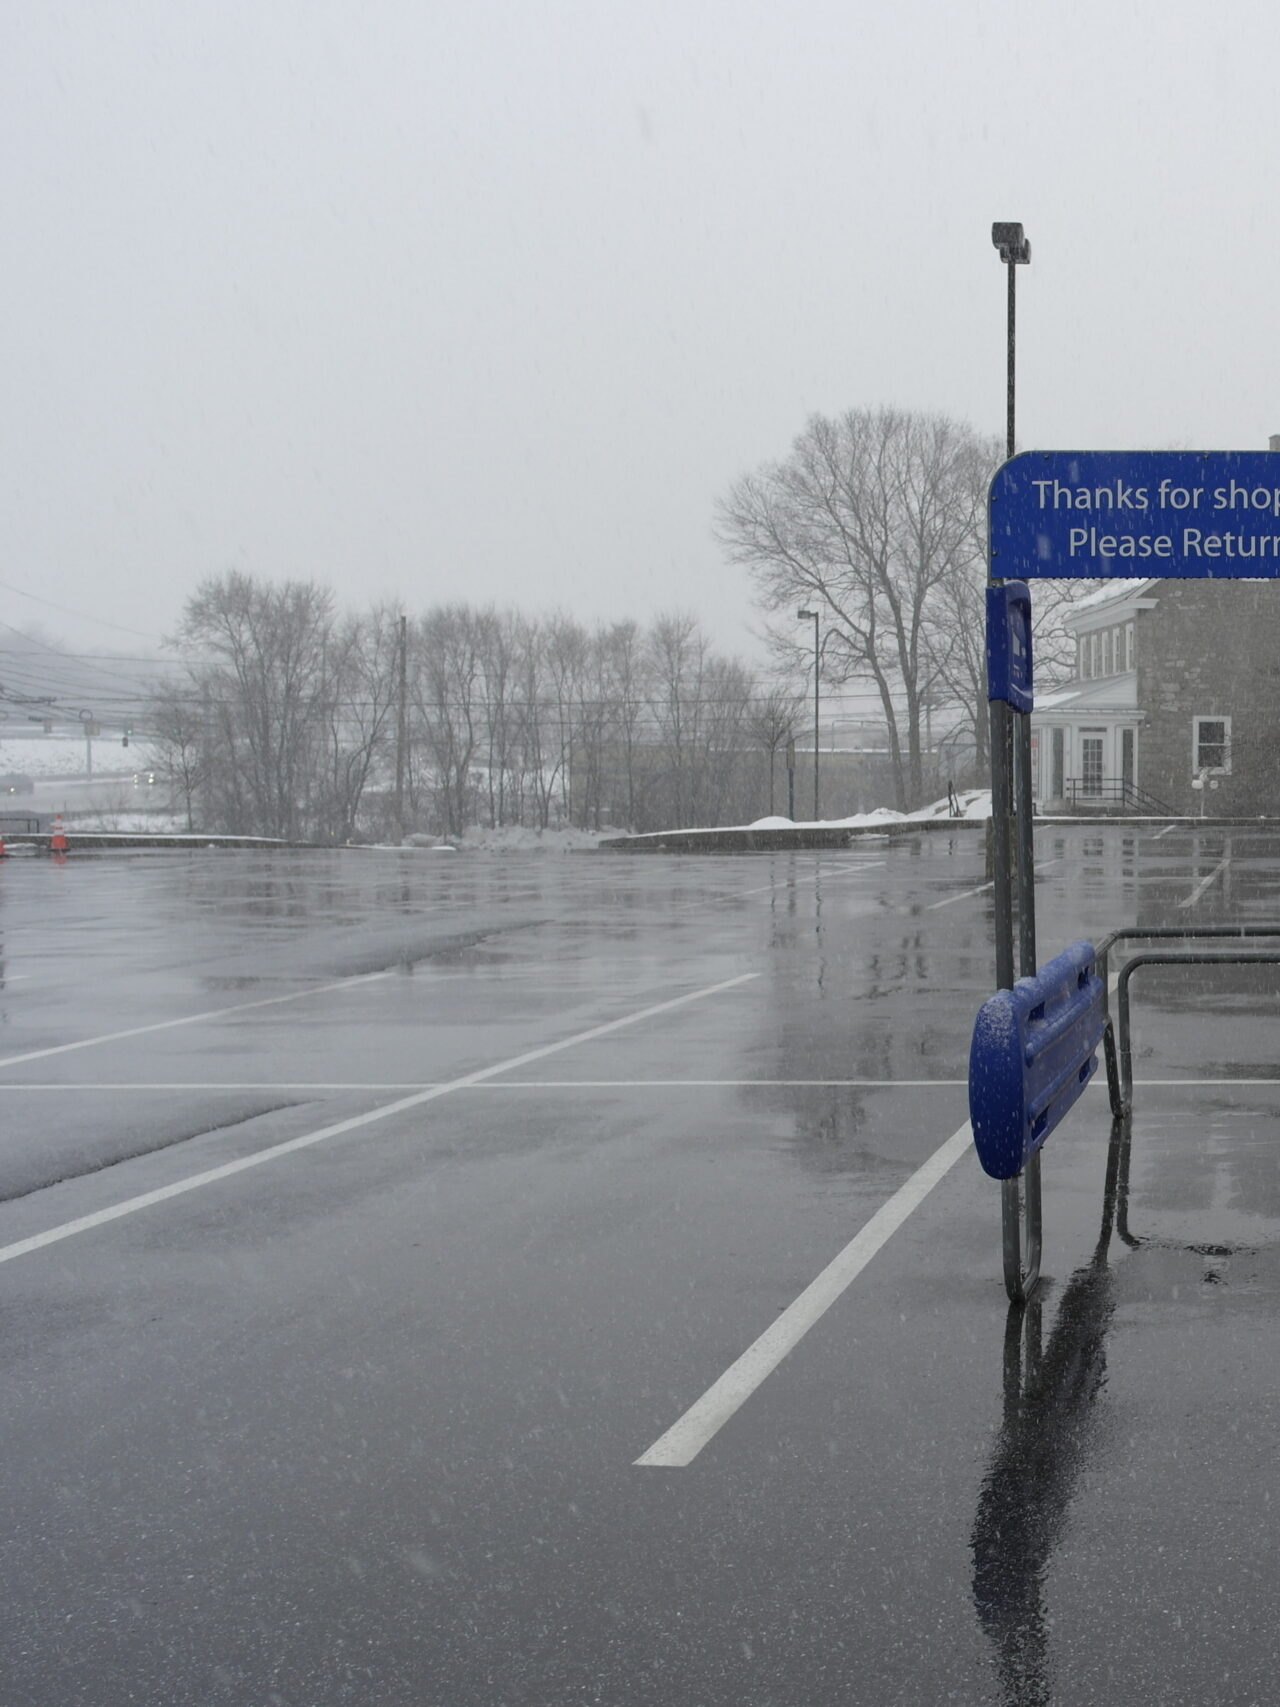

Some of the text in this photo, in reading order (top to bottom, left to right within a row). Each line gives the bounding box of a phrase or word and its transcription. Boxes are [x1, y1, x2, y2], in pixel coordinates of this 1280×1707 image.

[1031, 480, 1149, 509] Thanks
[1158, 479, 1204, 509] for
[1070, 528, 1172, 557] Please
